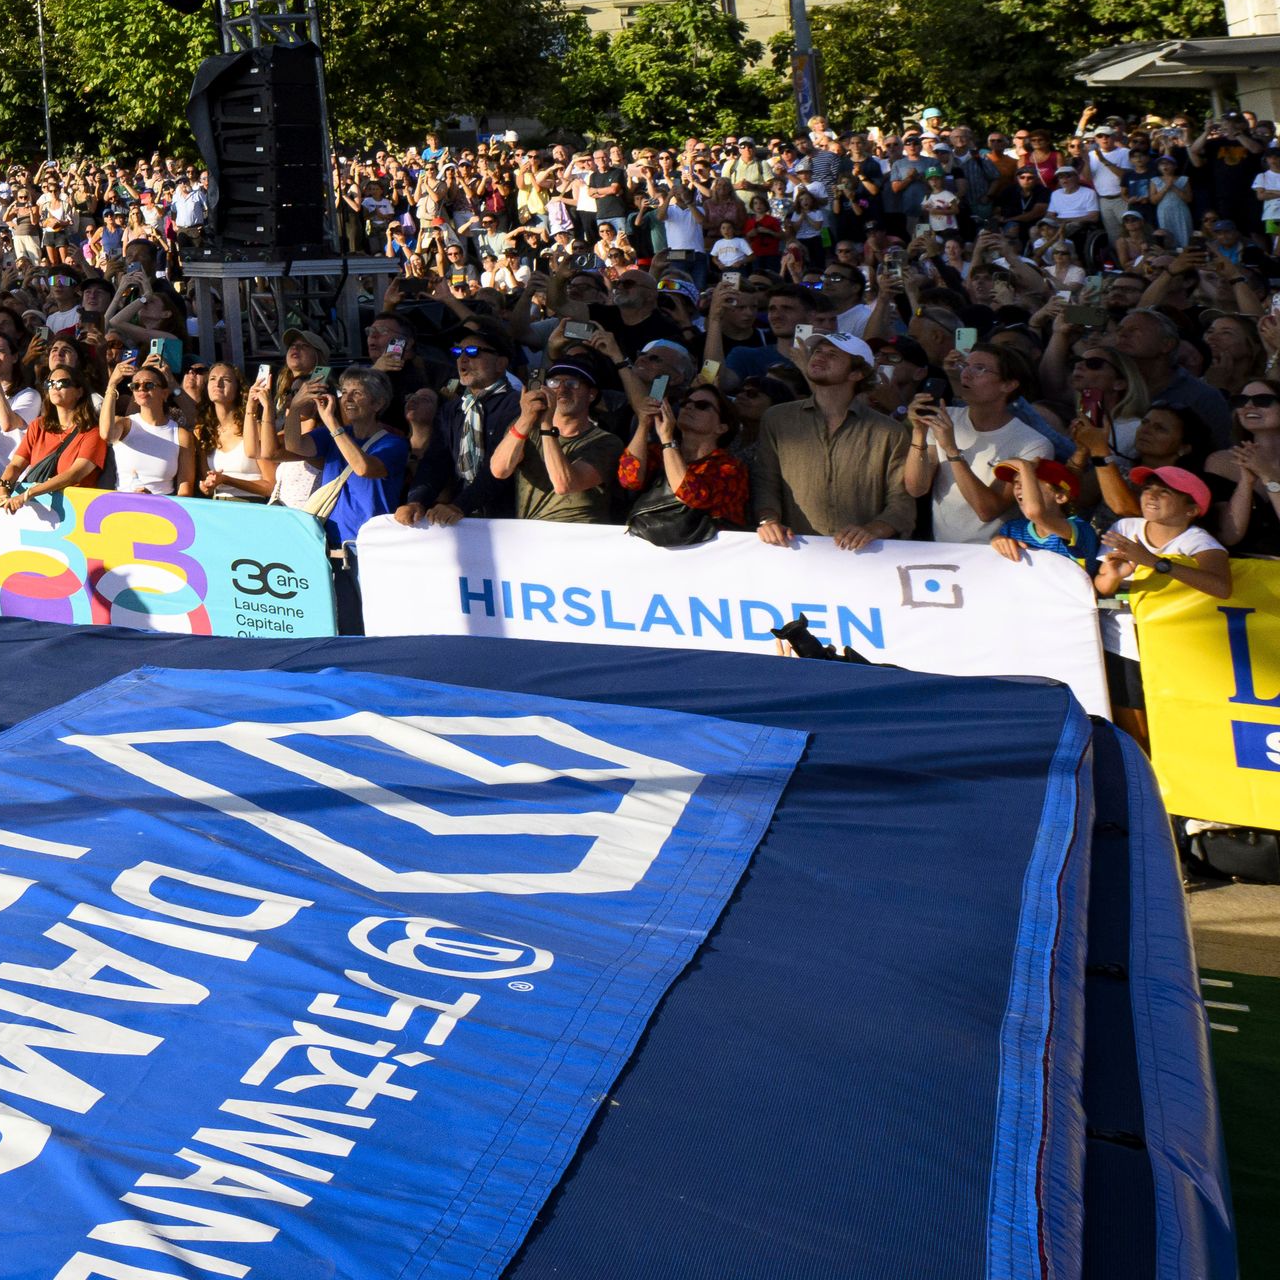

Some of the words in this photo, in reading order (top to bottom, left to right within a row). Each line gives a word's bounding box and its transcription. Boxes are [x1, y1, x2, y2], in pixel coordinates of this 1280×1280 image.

[276, 574, 310, 590] ans
[234, 597, 305, 619] Lausanne
[458, 576, 886, 651] HIRSLANDEN
[236, 613, 294, 634] Capitale
